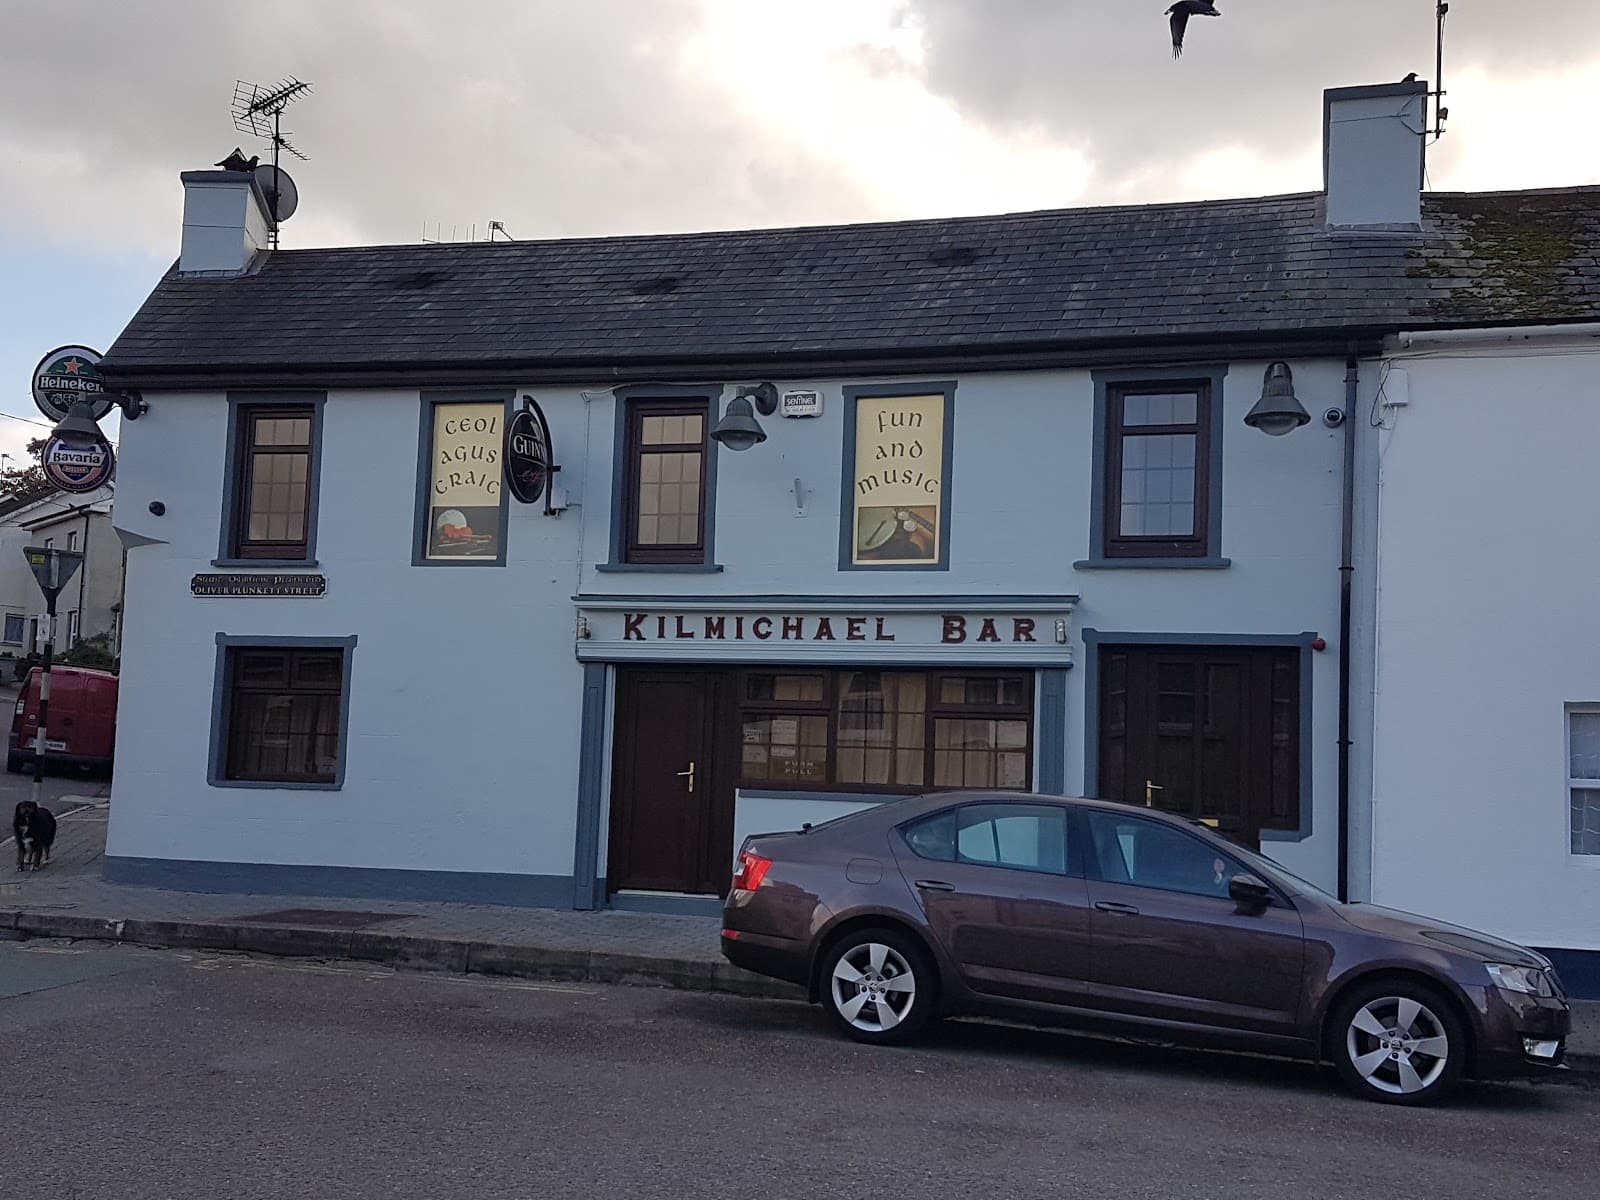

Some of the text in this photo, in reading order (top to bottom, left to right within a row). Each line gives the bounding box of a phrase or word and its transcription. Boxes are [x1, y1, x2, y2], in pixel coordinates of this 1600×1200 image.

[875, 440, 923, 460] and
[53, 452, 101, 465] Bavaria
[195, 586, 322, 594] OLIVER PLUNKETT STREET
[623, 612, 1037, 643] KILMICHAEL BAR
